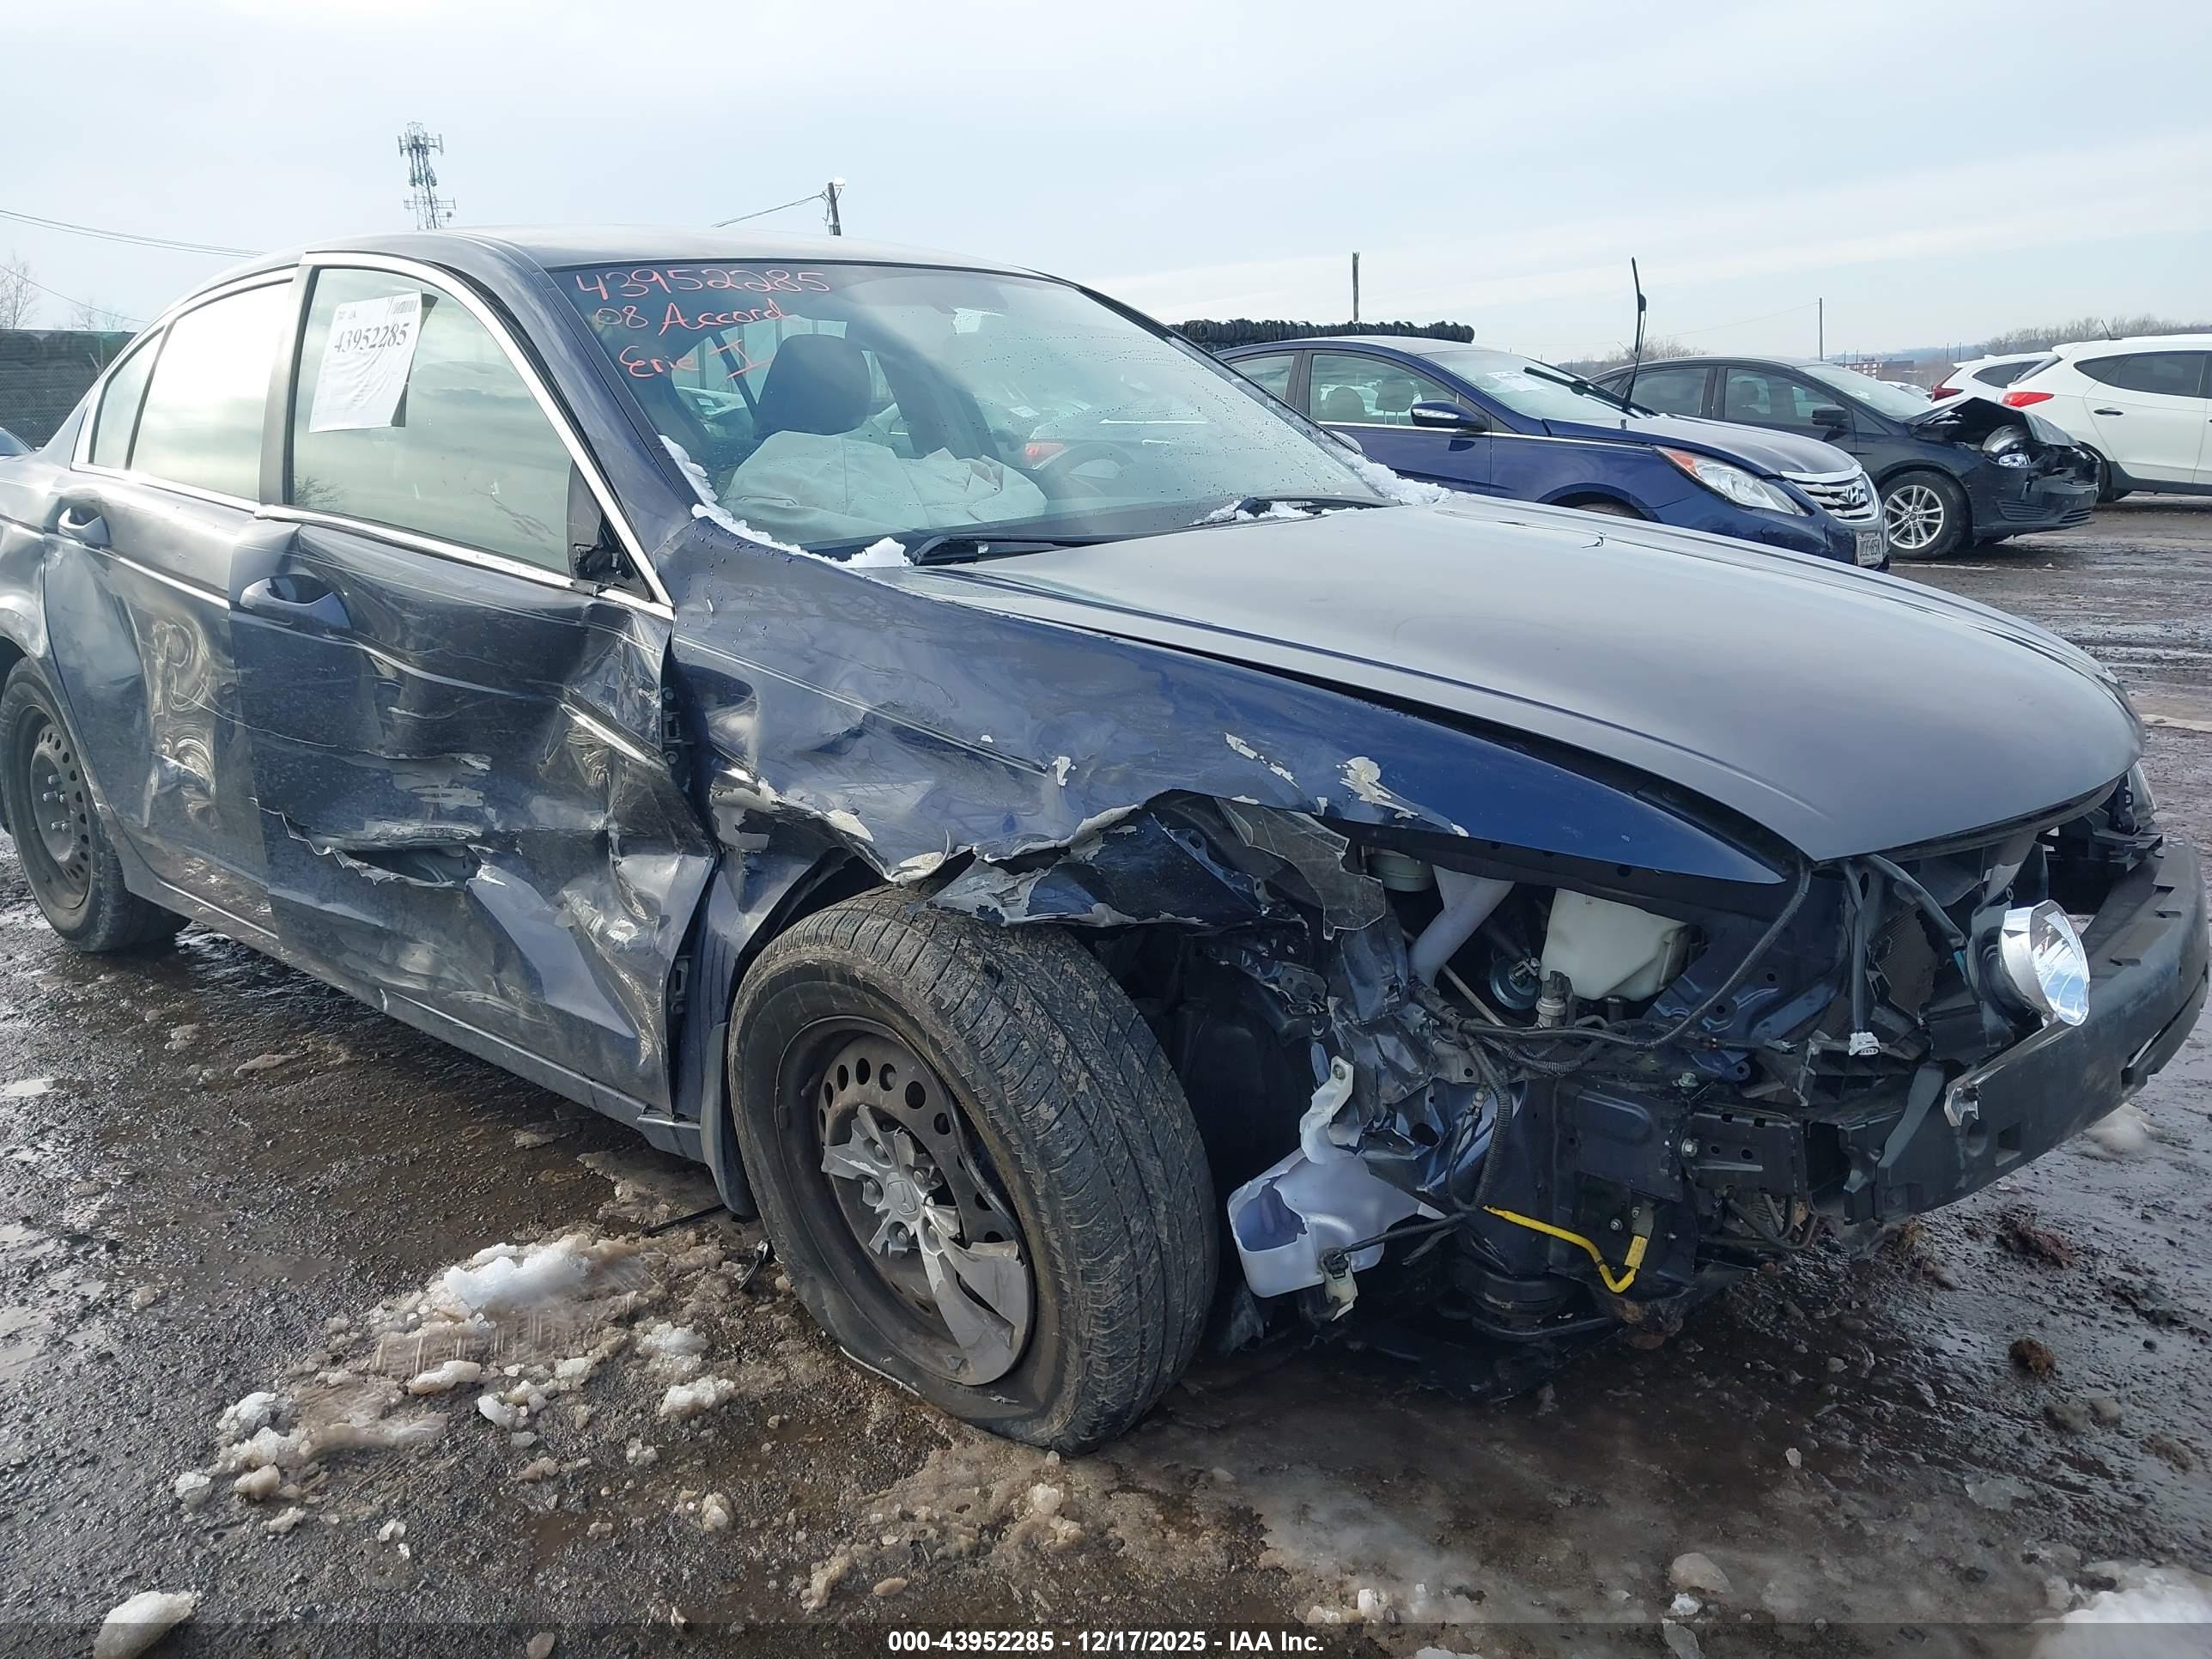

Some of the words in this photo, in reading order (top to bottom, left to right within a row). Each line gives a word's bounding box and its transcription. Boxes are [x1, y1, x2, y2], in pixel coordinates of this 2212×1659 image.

[575, 268, 830, 301] 43952285
[595, 305, 648, 329] 08
[658, 298, 799, 337] Accord
[334, 322, 410, 353] 43952285
